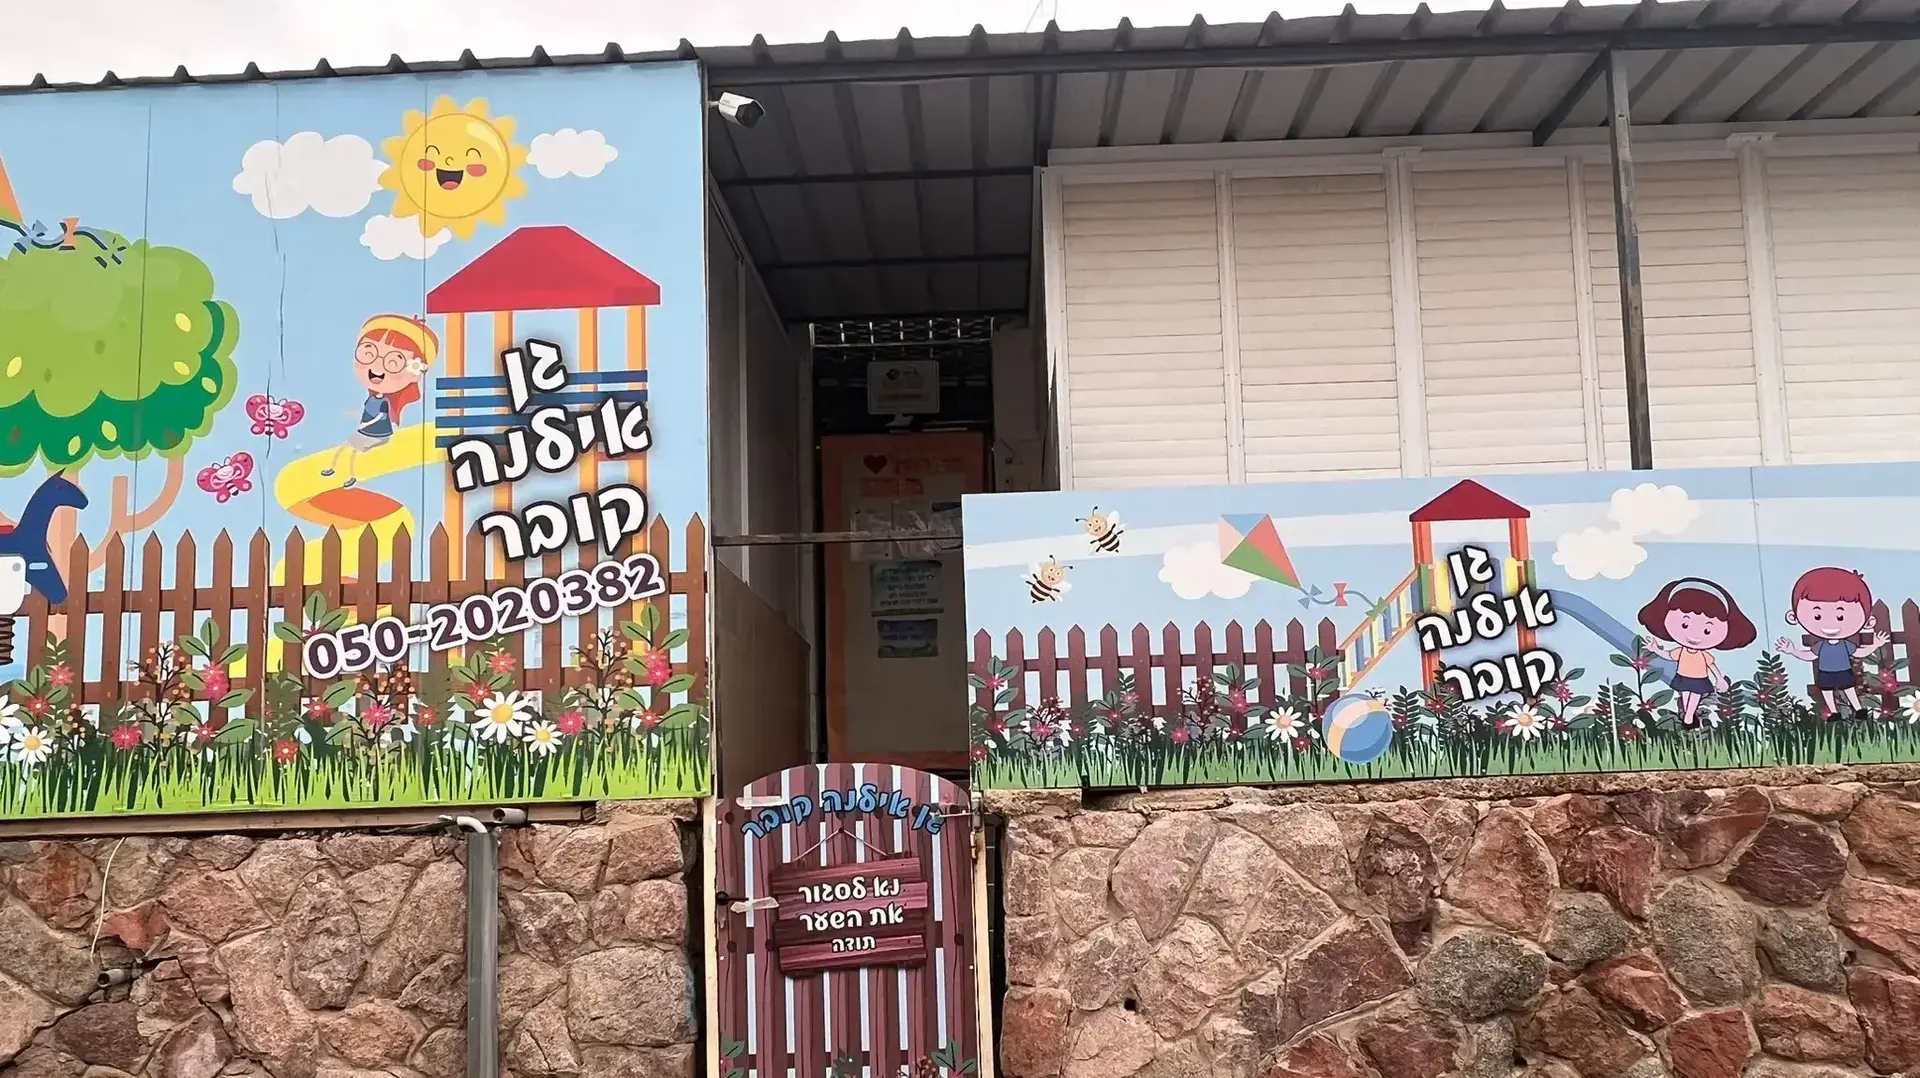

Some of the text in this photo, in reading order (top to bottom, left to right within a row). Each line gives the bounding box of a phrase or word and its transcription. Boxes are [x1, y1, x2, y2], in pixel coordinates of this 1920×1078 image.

[502, 339, 567, 412] גן
[450, 396, 650, 491] אילנה
[480, 485, 648, 560] קובר
[1447, 545, 1493, 598] גן
[305, 555, 663, 677] 050-2020382
[1416, 585, 1557, 652] אילנה
[1443, 648, 1557, 701] קובר
[741, 783, 947, 839] גן אילנה קובר
[798, 876, 900, 904] נא לסגור
[799, 904, 904, 932] את השער
[832, 935, 876, 952] תודה
